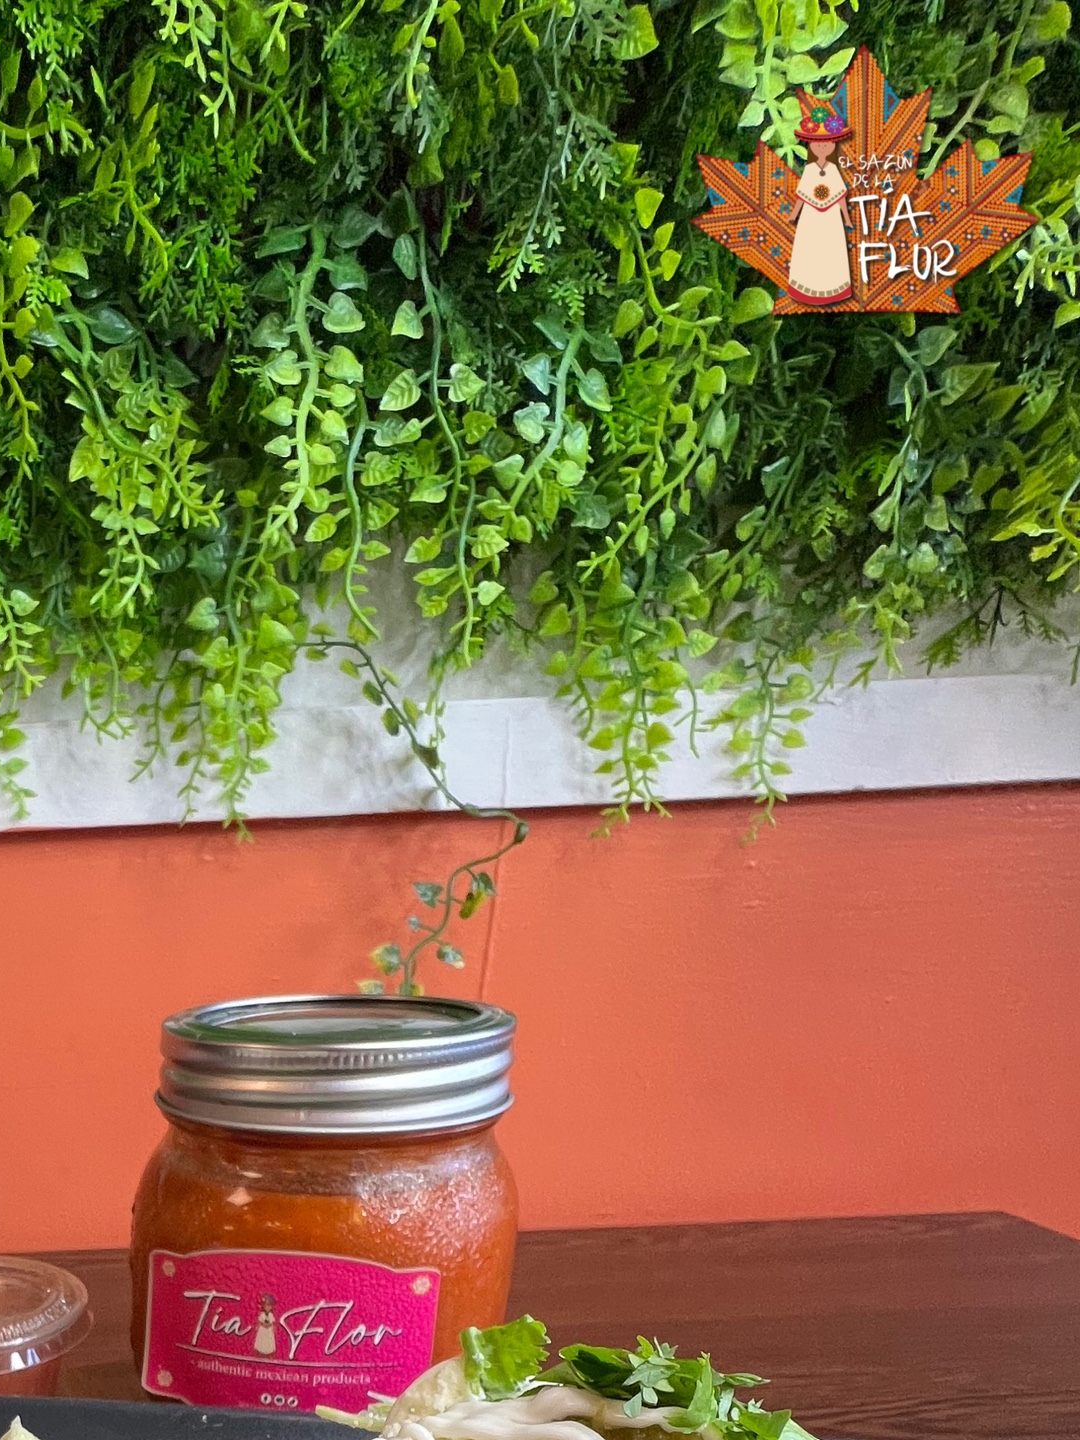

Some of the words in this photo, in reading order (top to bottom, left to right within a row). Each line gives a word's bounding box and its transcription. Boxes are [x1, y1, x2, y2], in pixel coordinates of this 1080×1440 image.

[183, 1290, 252, 1347] Tia
[279, 1299, 403, 1361] Flor
[197, 1359, 252, 1379] authentic
[255, 1369, 309, 1384] mexican
[313, 1373, 371, 1387] products
